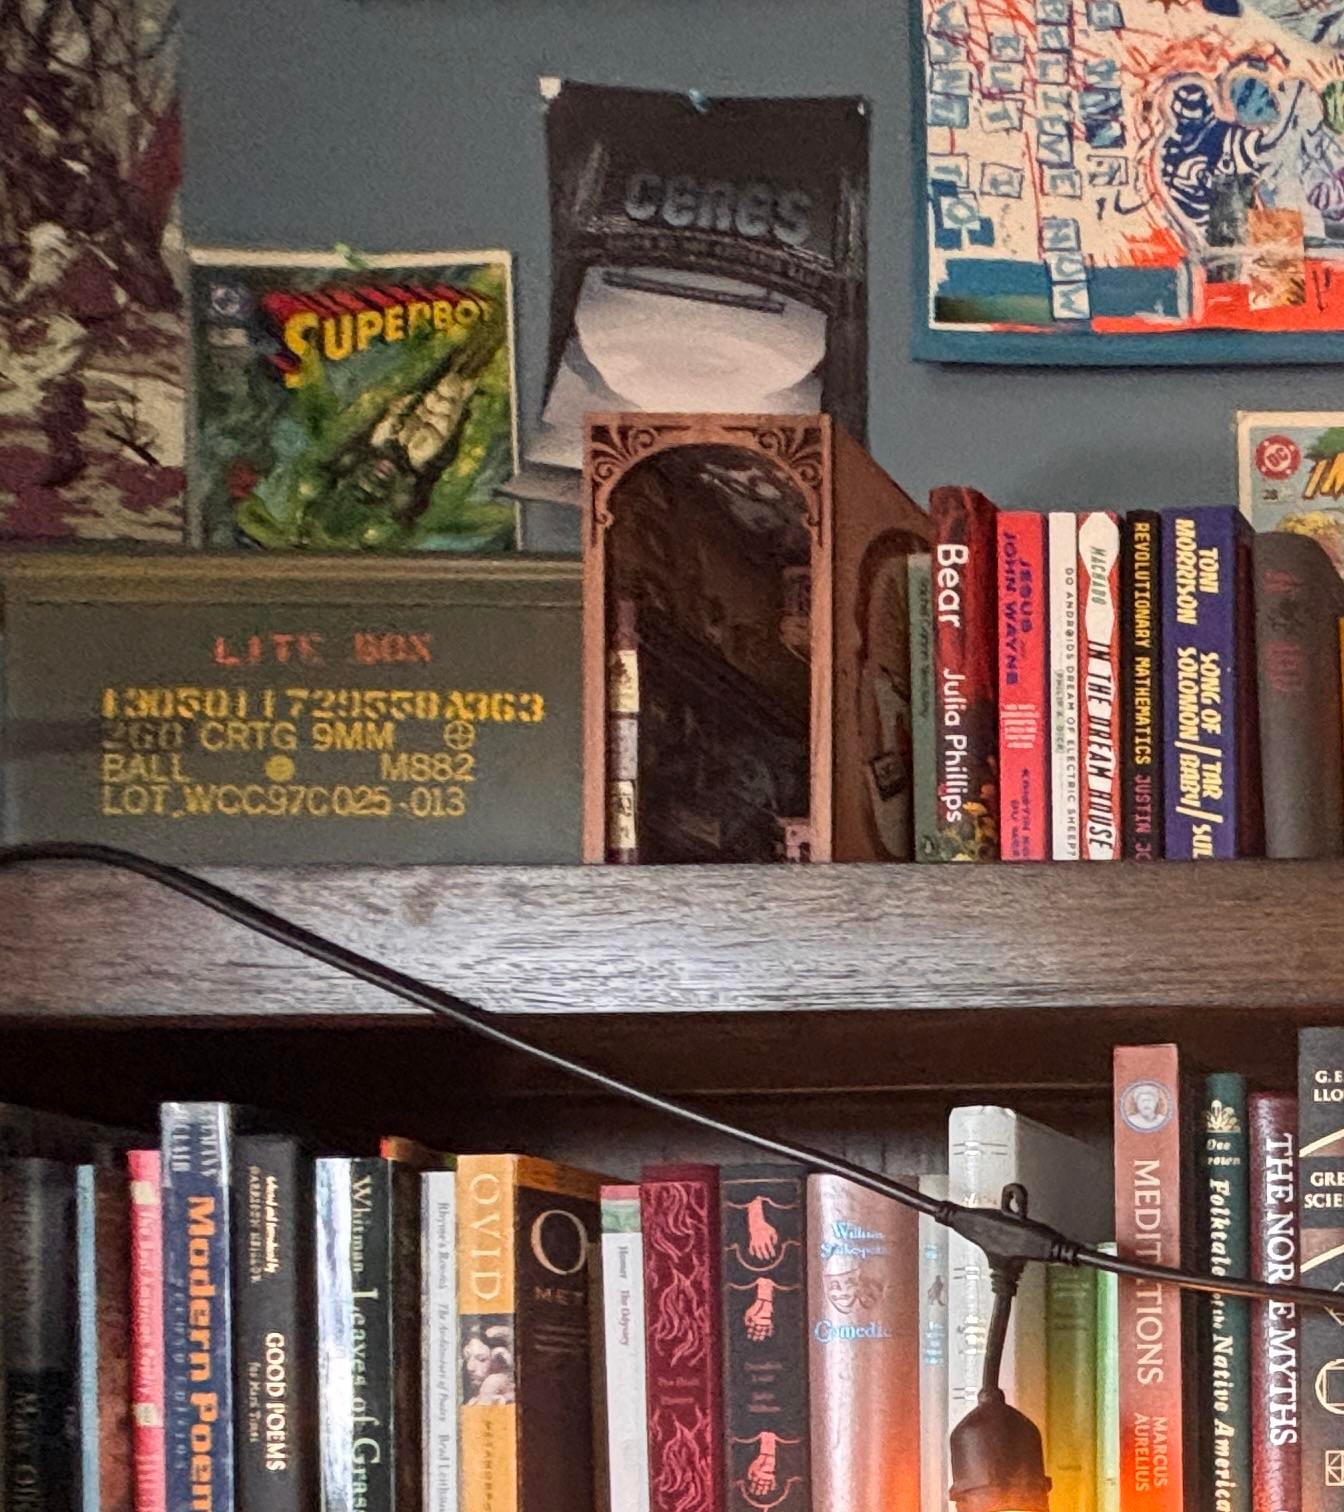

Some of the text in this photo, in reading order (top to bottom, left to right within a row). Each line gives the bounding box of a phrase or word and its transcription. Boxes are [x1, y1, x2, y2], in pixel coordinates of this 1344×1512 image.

[1174, 518, 1198, 626] MORRISON
[1199, 547, 1220, 595] TONI
[936, 543, 969, 823] Bear Julia Phillips
[1133, 522, 1151, 766] REVOLUTIONARY MATHEMATICS
[1176, 646, 1199, 741] SOLOMON
[101, 753, 476, 783] BALL M882
[200, 721, 396, 751] CRTG 9MM
[1199, 651, 1223, 801] SONG OF TAR
[186, 1196, 215, 1382] Modern
[467, 1173, 503, 1300] OVID
[1132, 1159, 1164, 1387] MEDITTIONS
[265, 1332, 287, 1472] GOOD POEMS
[1133, 1411, 1149, 1493] AURELIUS
[1152, 1415, 1168, 1487] MARCUS
